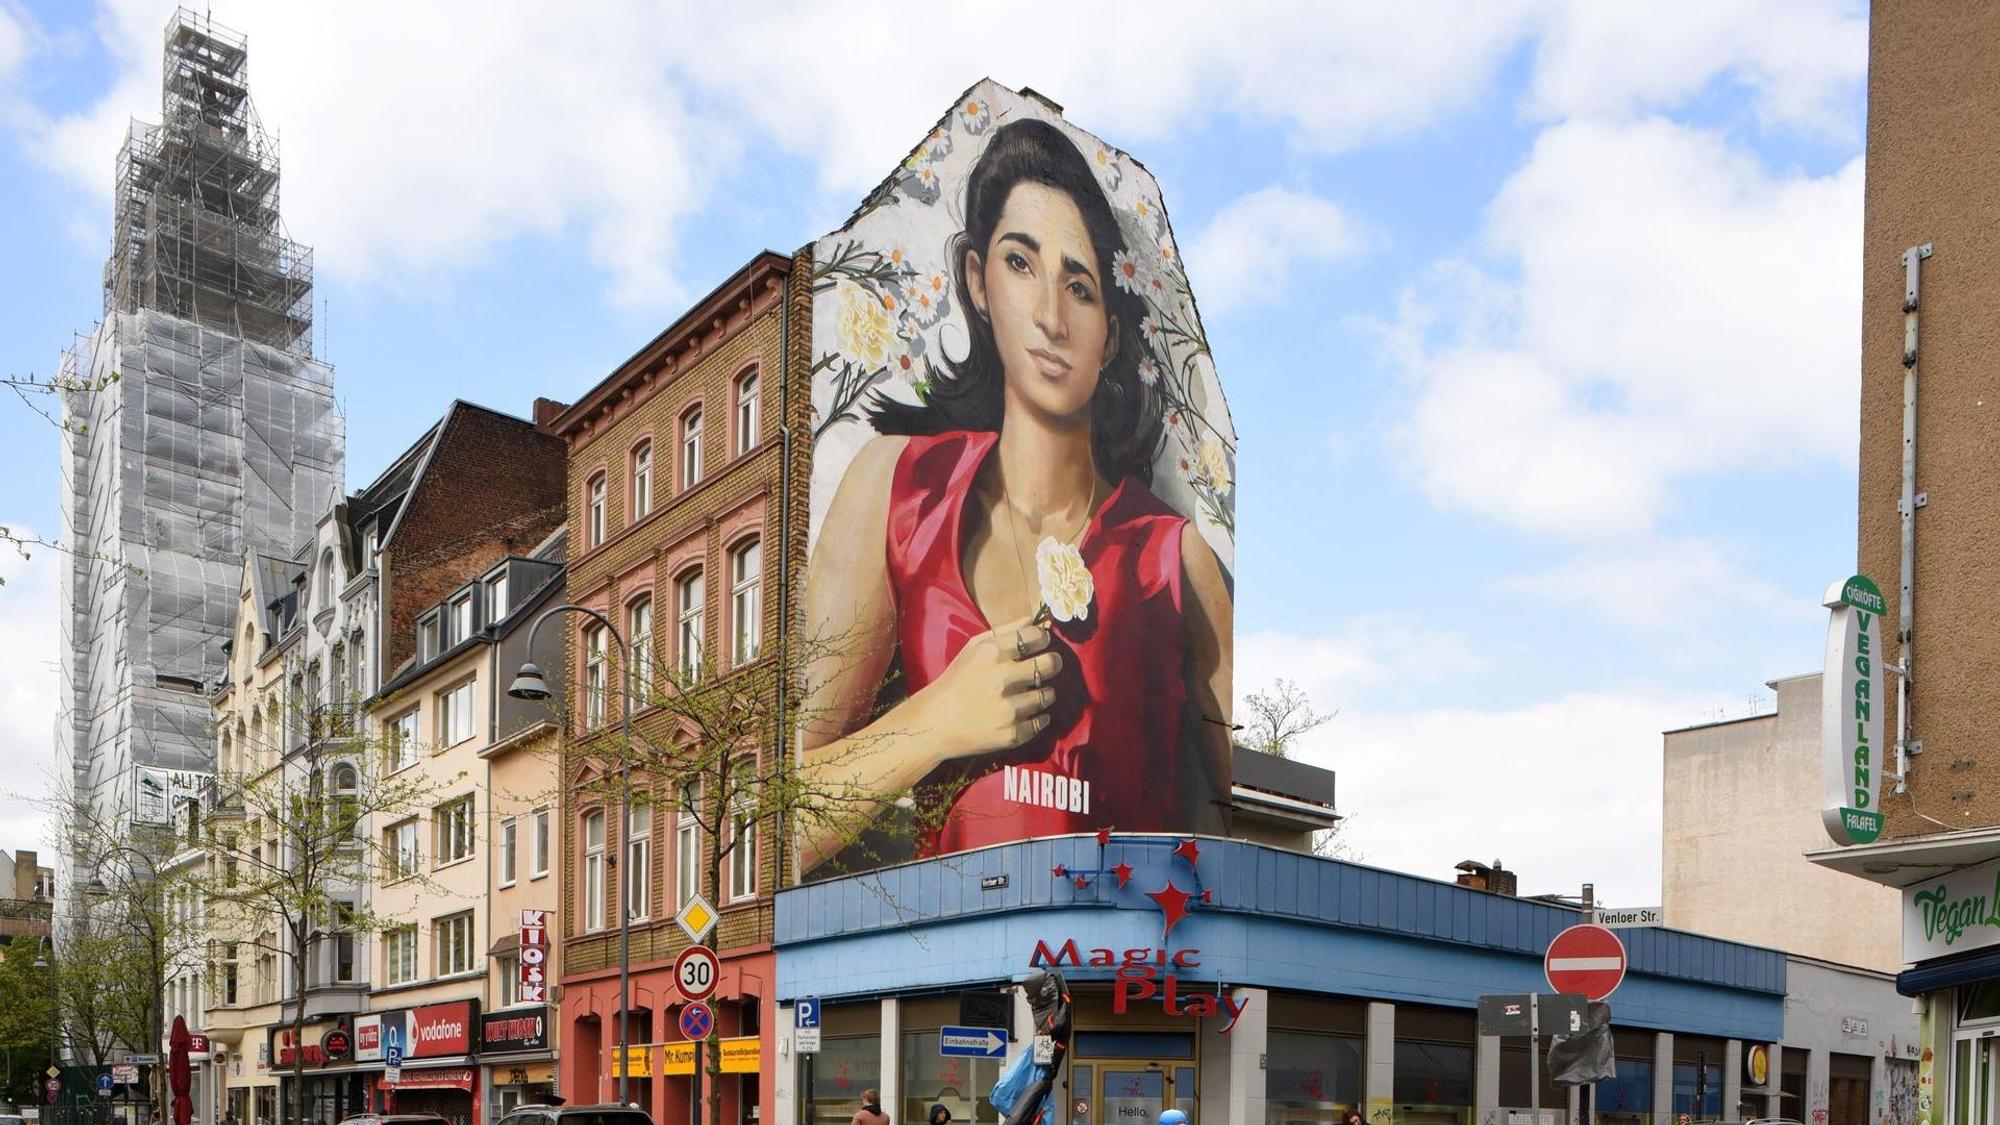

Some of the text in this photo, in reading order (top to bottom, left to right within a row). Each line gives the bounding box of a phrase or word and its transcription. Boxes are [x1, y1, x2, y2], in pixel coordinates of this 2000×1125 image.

[1855, 610, 1871, 809] VEGANLAND
[1004, 765, 1090, 815] NAIROBI
[1847, 813, 1878, 832] FALAFEL
[1599, 910, 1660, 924] Venloer Str.
[1914, 884, 1986, 945] Vegan
[522, 910, 545, 1002] KIOSK
[684, 962, 710, 986] 30
[1029, 938, 1201, 981] Magic
[1113, 974, 1249, 1034] Play
[420, 1019, 462, 1042] vodafone
